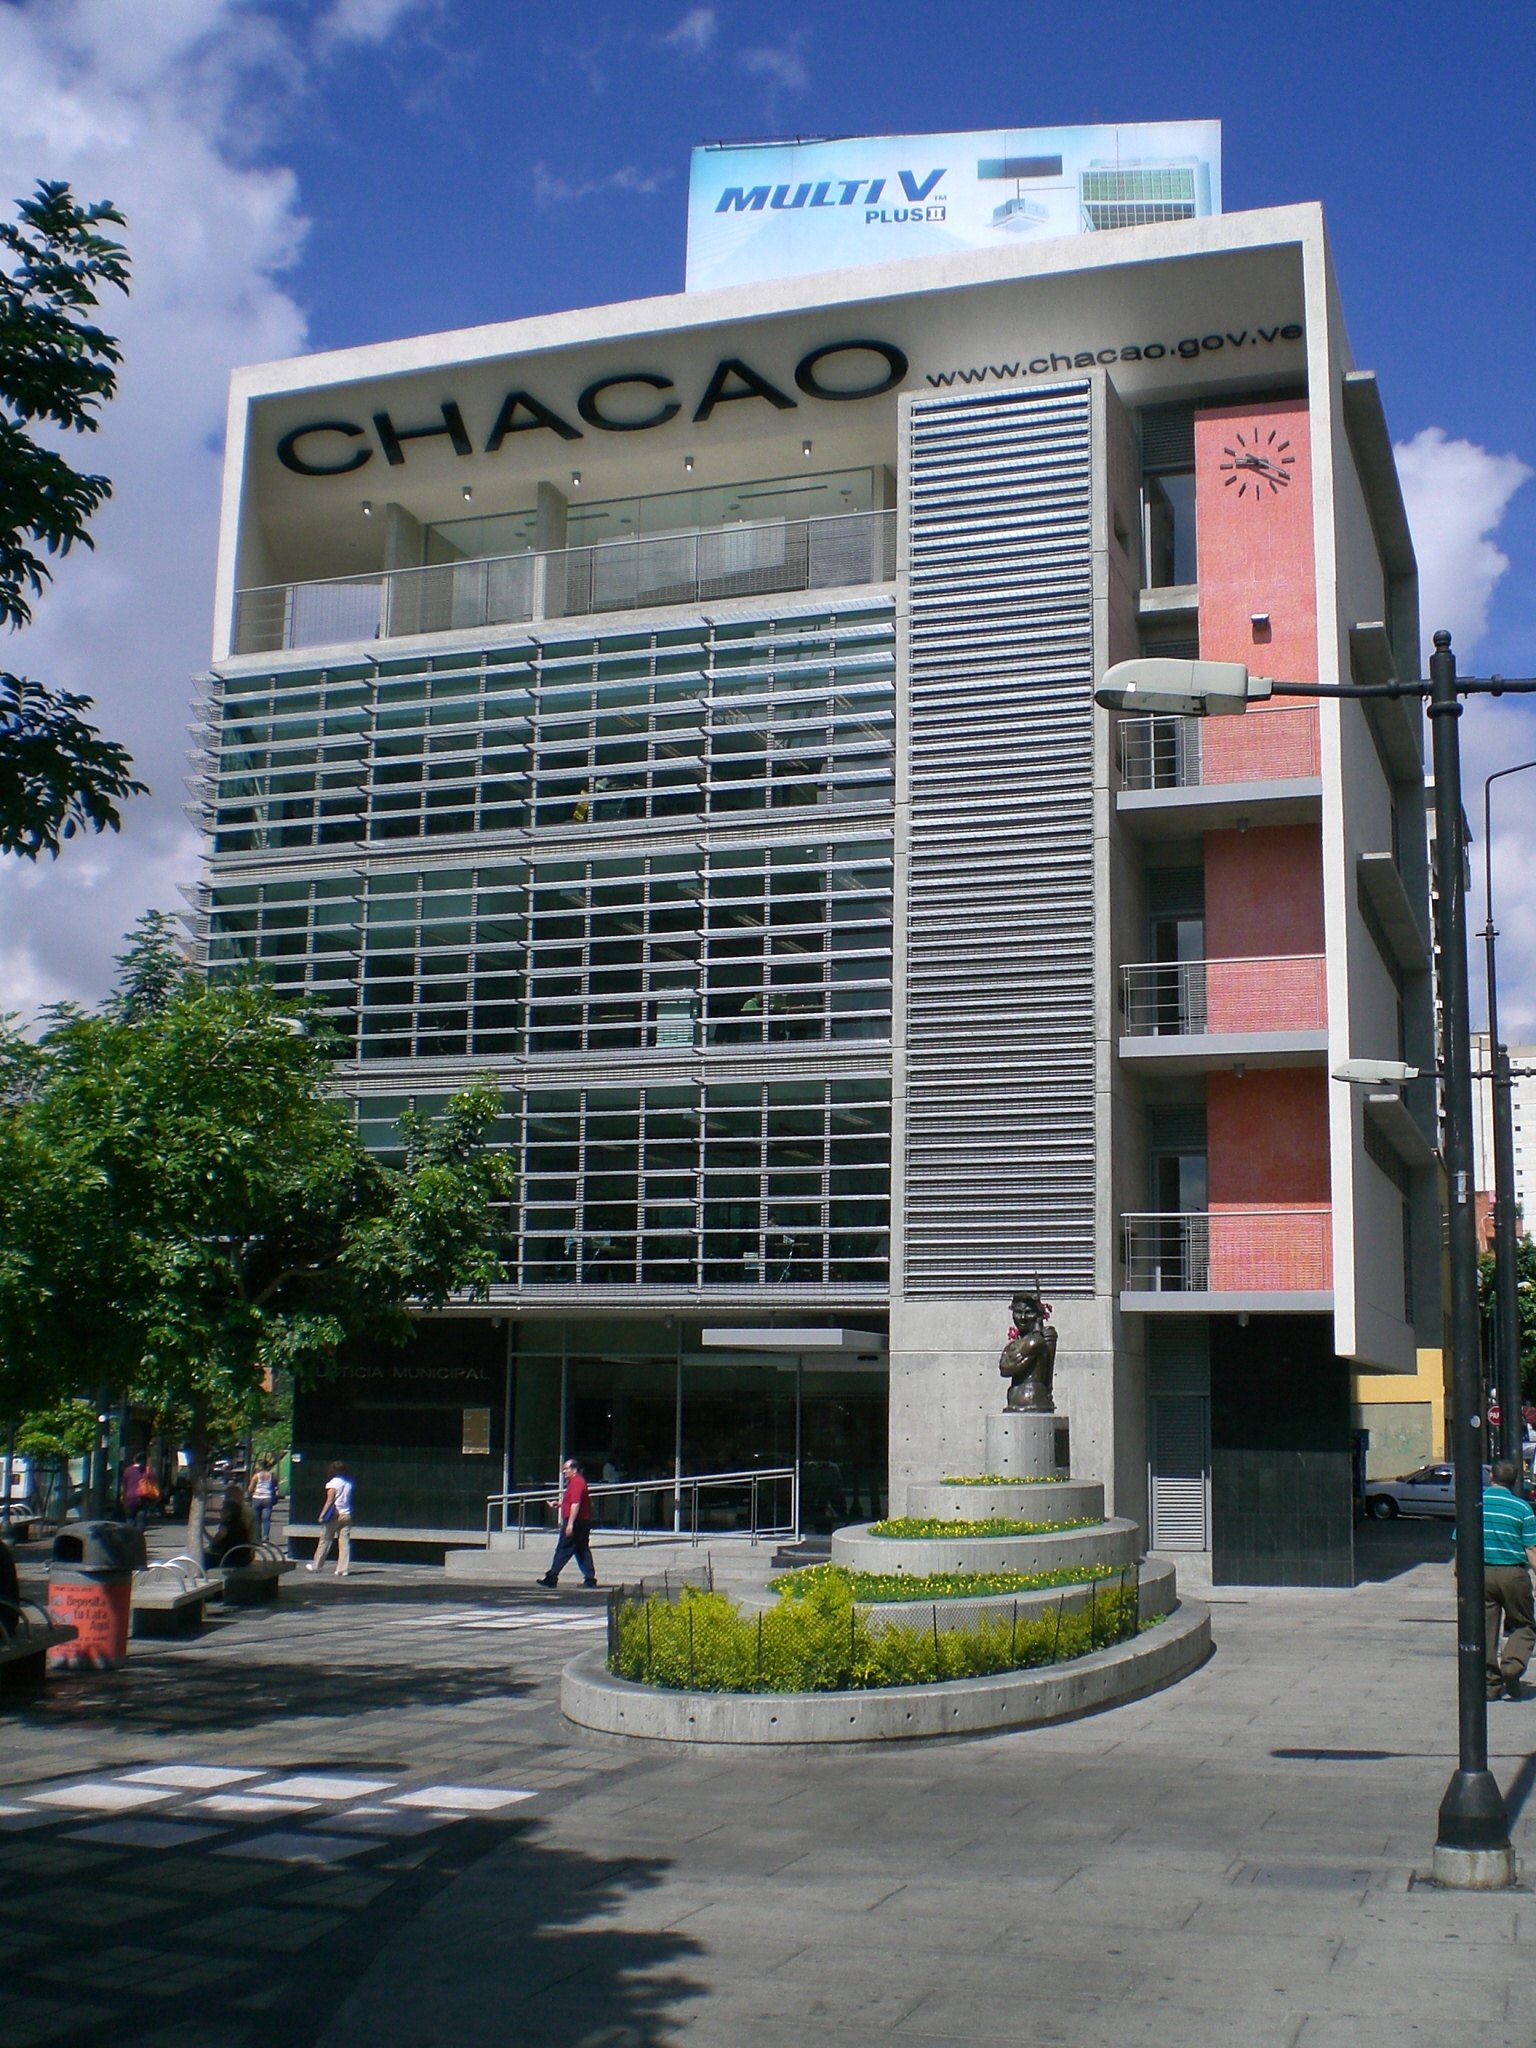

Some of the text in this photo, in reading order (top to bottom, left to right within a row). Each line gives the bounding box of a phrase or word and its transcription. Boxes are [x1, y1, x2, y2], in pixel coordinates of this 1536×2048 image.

[714, 178, 887, 213] MULTI
[897, 168, 948, 202] V
[865, 207, 924, 225] PLUS
[926, 323, 1304, 388] www.chacao.gov.ve
[276, 339, 909, 476] CHACAO
[316, 1366, 490, 1380] USTICIA MUNICIPAL
